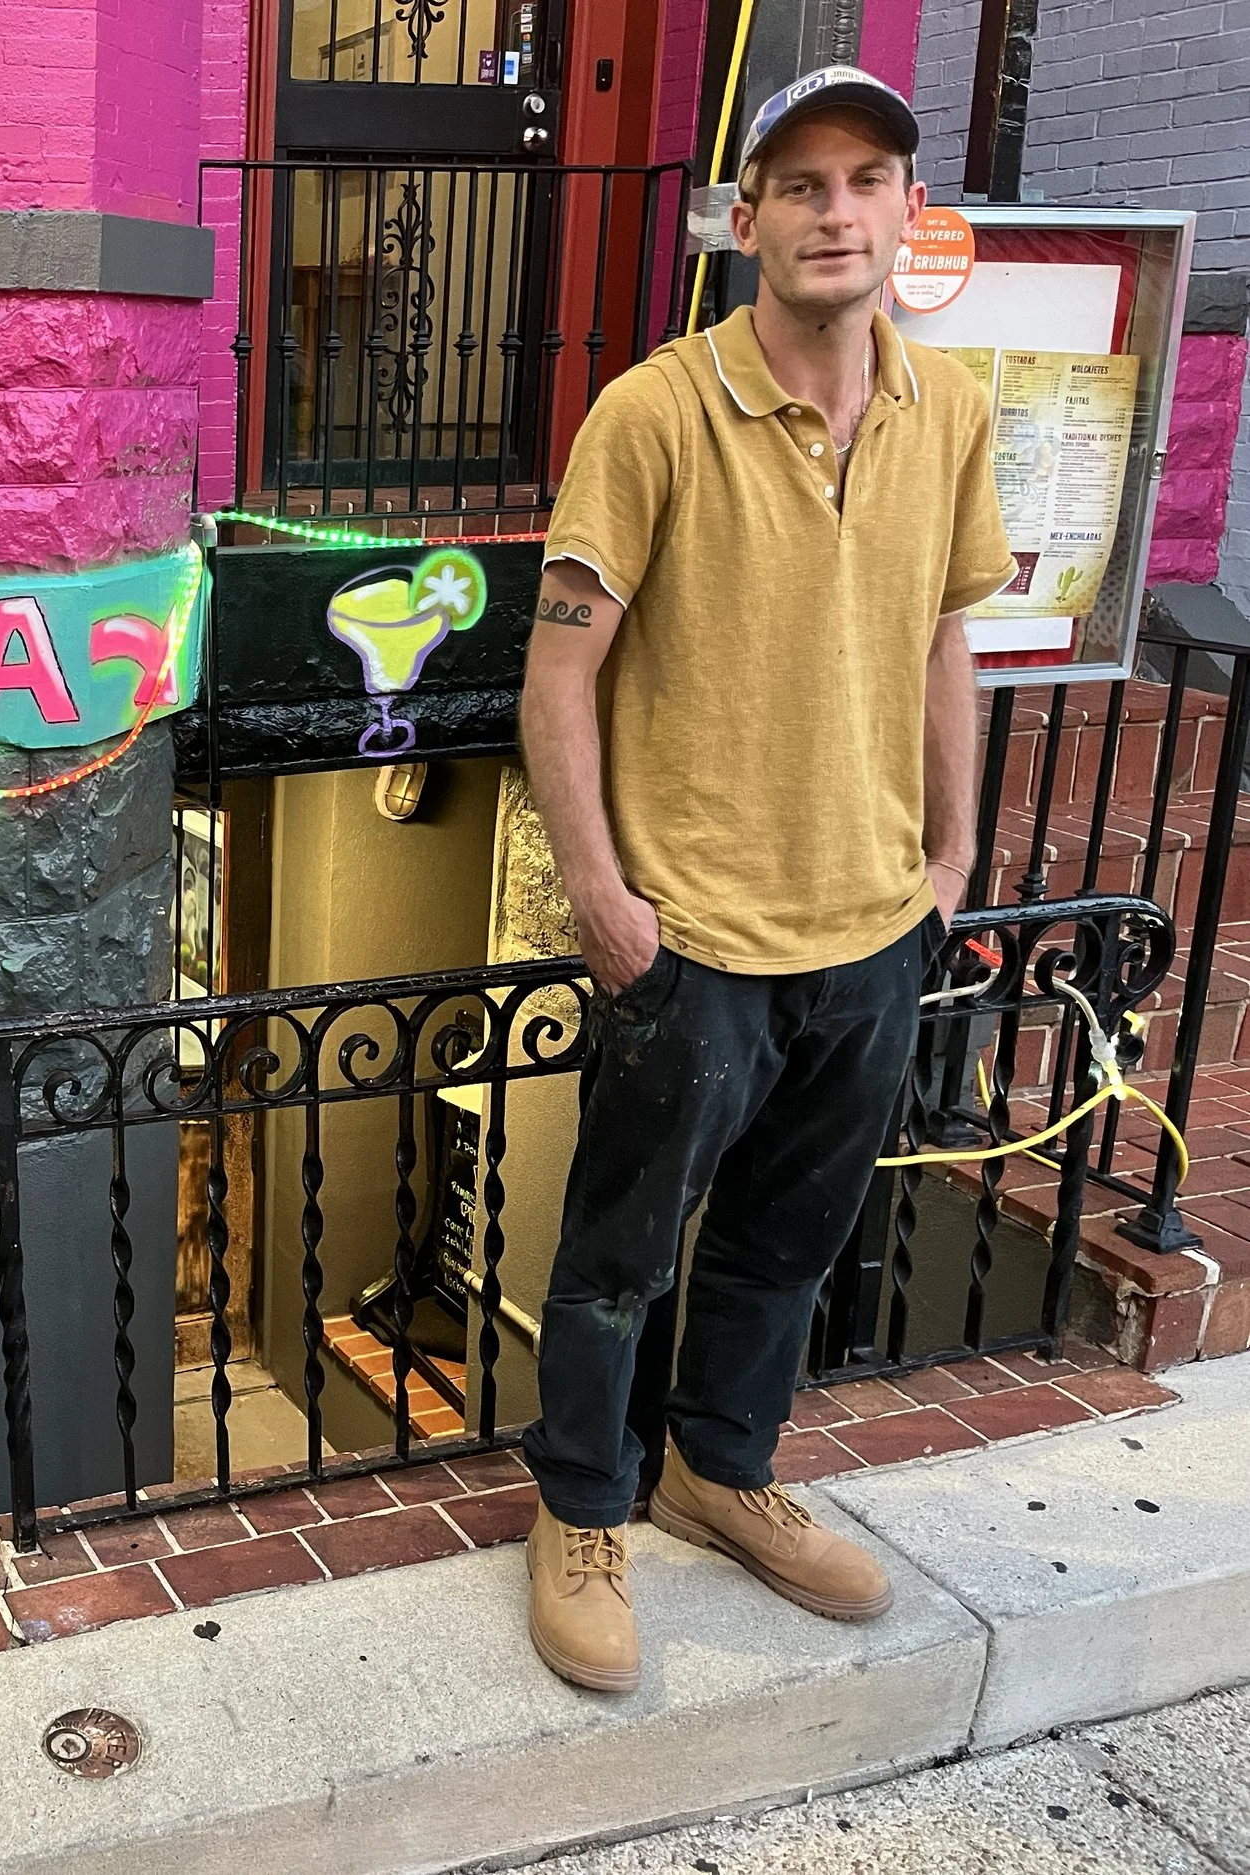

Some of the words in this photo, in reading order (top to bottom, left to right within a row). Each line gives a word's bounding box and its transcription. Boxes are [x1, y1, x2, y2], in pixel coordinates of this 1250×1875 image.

[913, 230, 965, 241] ELIVERED
[914, 254, 968, 270] GRUBHUB
[1005, 355, 1036, 365] TOSTADAS
[1071, 364, 1109, 374] MOLCAJETES
[1065, 396, 1090, 405] FAJITAS
[1000, 408, 1029, 417] BURRITOS
[1062, 432, 1098, 441] TRADITIONAL
[1099, 434, 1122, 442] DISHES
[994, 452, 1017, 462] TORTAS
[1049, 532, 1102, 541] MEX-ENCHILADAS
